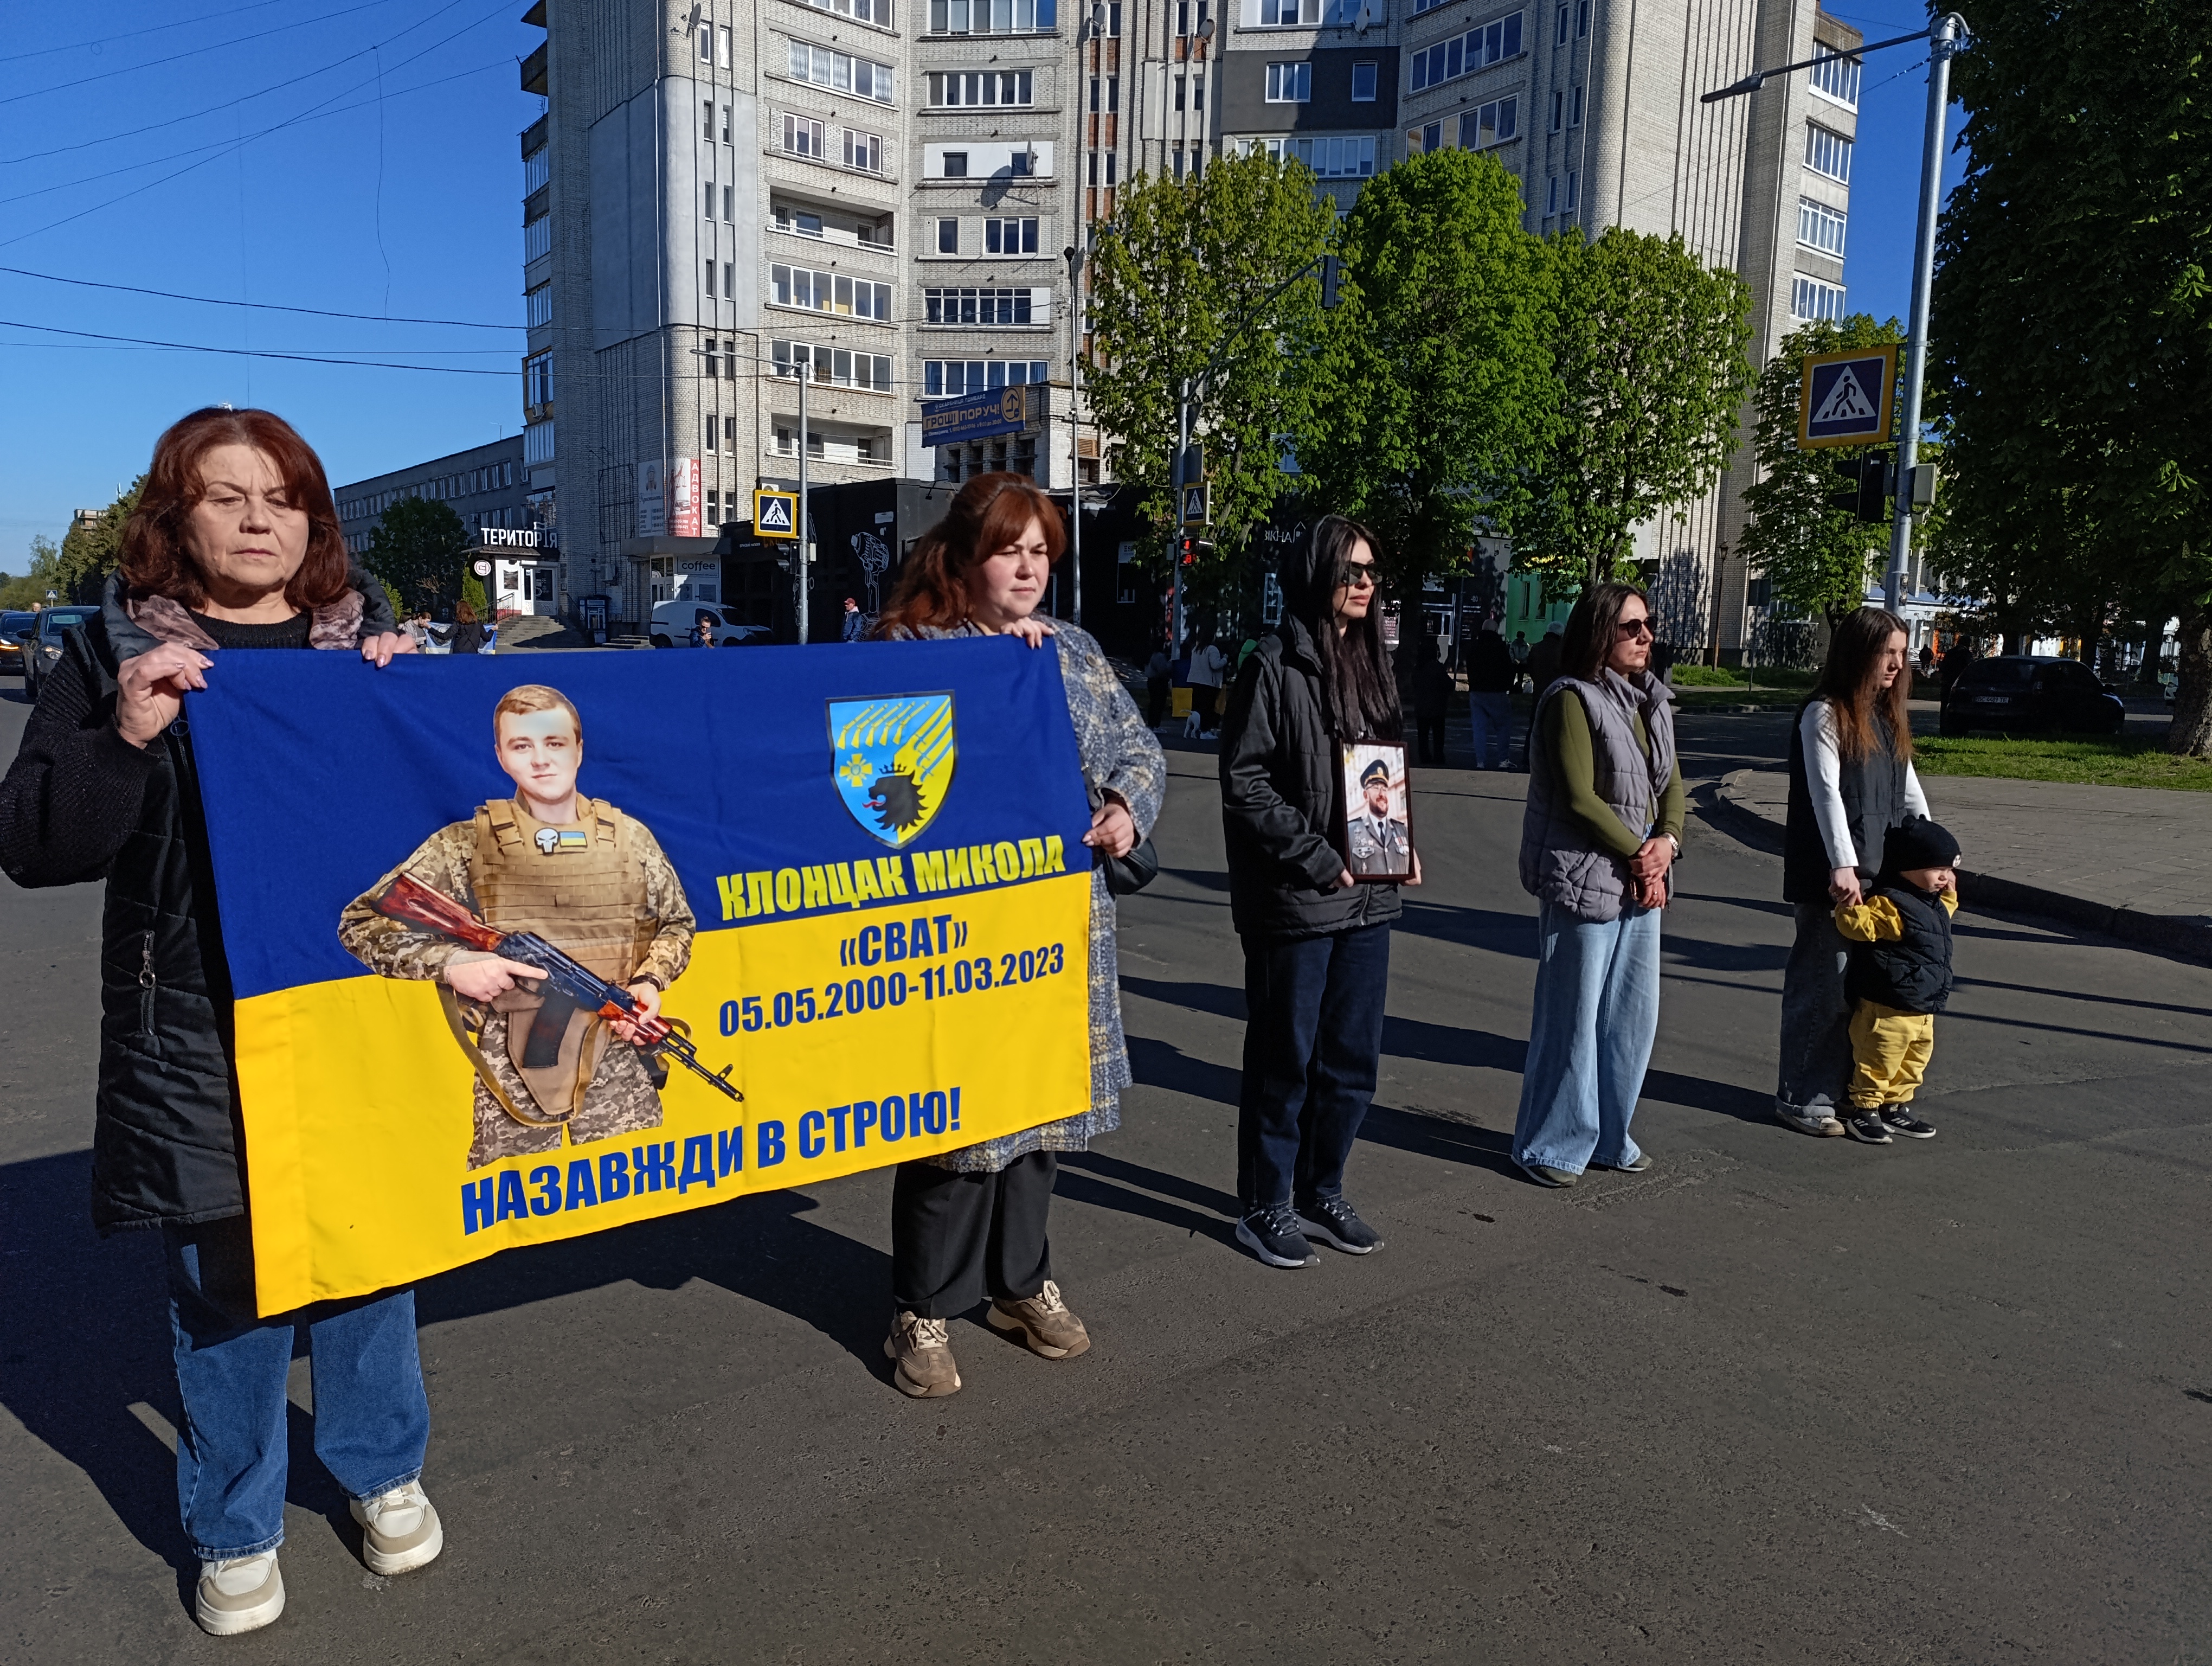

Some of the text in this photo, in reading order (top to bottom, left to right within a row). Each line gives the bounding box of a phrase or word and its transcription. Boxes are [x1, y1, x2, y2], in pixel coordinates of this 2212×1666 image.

[926, 403, 1000, 428] ГРОШІ ПОРУЧ!
[964, 394, 986, 402] ЛОМБАРД
[691, 463, 699, 536] АДВОКАТ
[480, 523, 557, 548] ТЕРИТОРІЯ
[681, 561, 716, 571] coffee
[716, 835, 1066, 921] КЛОНЦАК МИКОЛА
[840, 914, 968, 967] «СВАТ»
[719, 943, 1064, 1036] 05.05.2000-11.03.2023
[460, 1086, 961, 1236] НАЗАВЖДИ В СТРОЮ!
